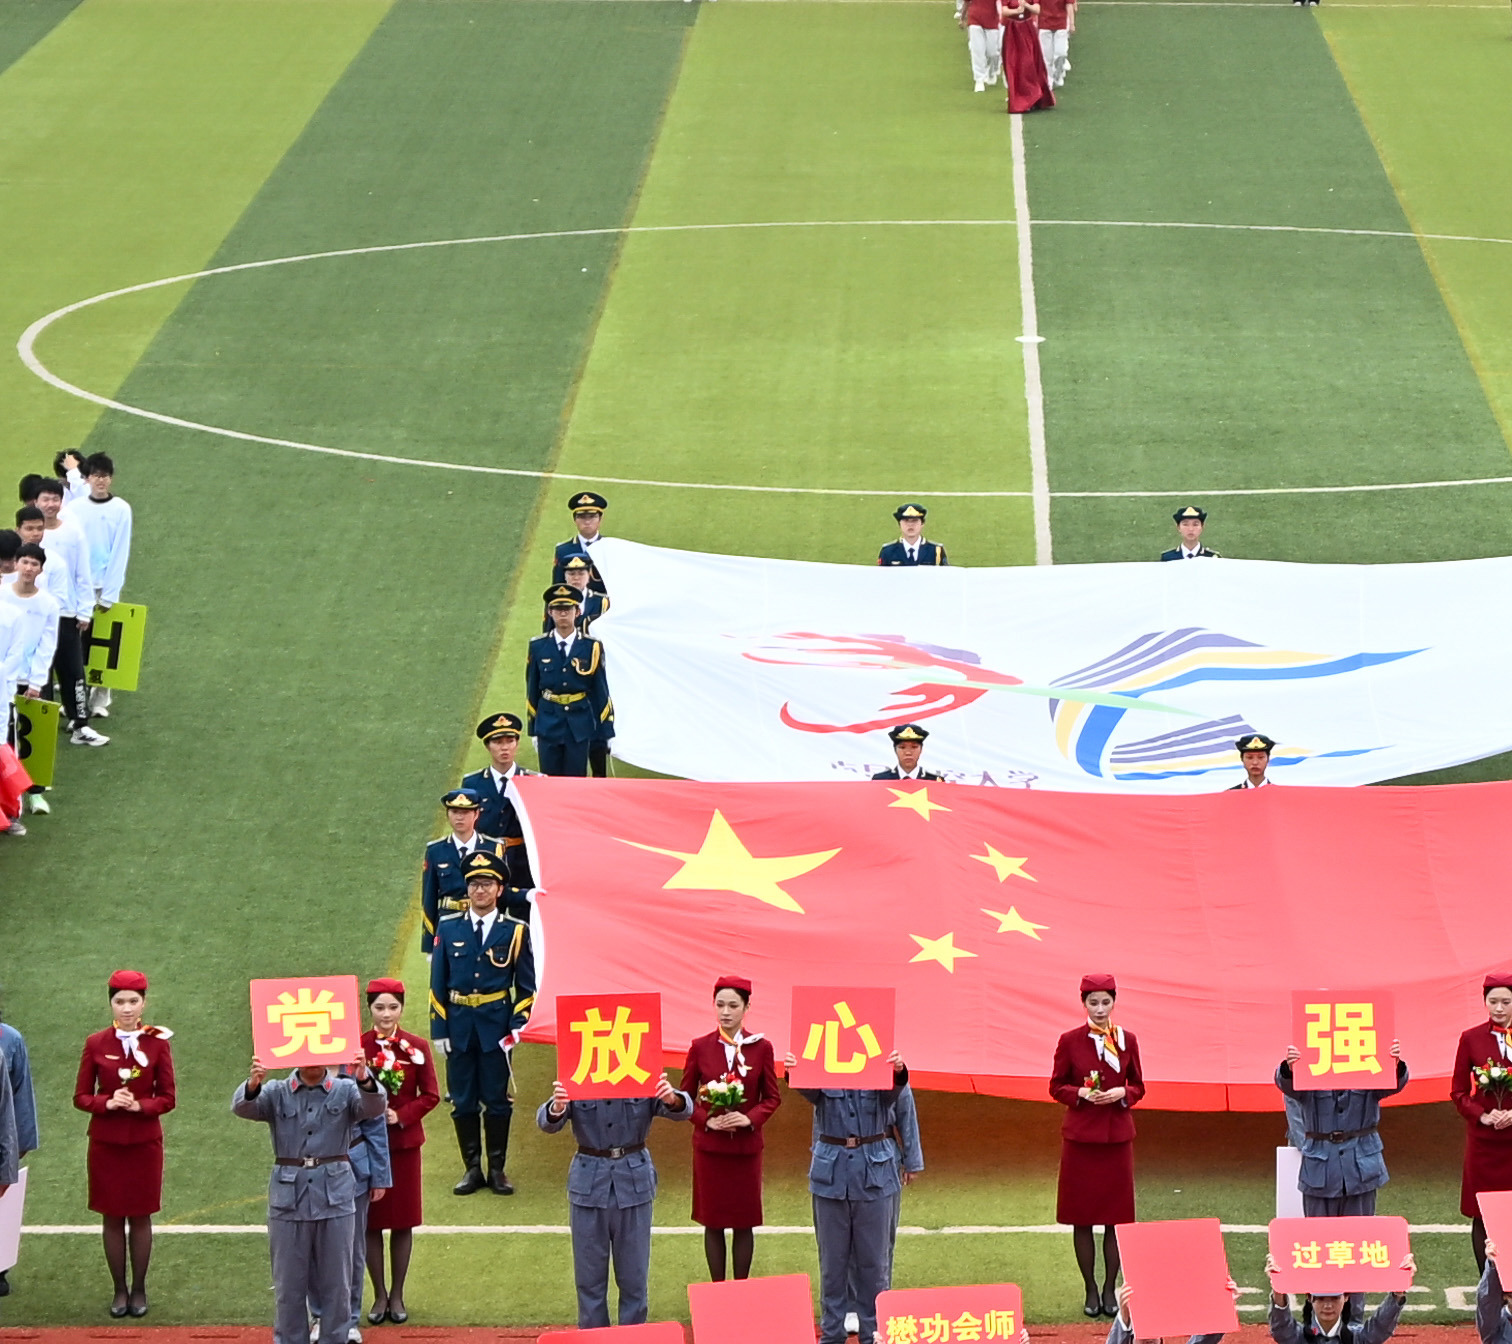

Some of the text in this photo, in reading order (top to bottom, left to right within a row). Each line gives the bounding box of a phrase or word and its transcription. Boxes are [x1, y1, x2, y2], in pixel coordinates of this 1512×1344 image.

[266, 988, 346, 1058] 党
[570, 1006, 651, 1085] 放
[802, 1001, 882, 1074] 心
[1305, 1002, 1383, 1076] 强
[1293, 1240, 1391, 1269] 过草地
